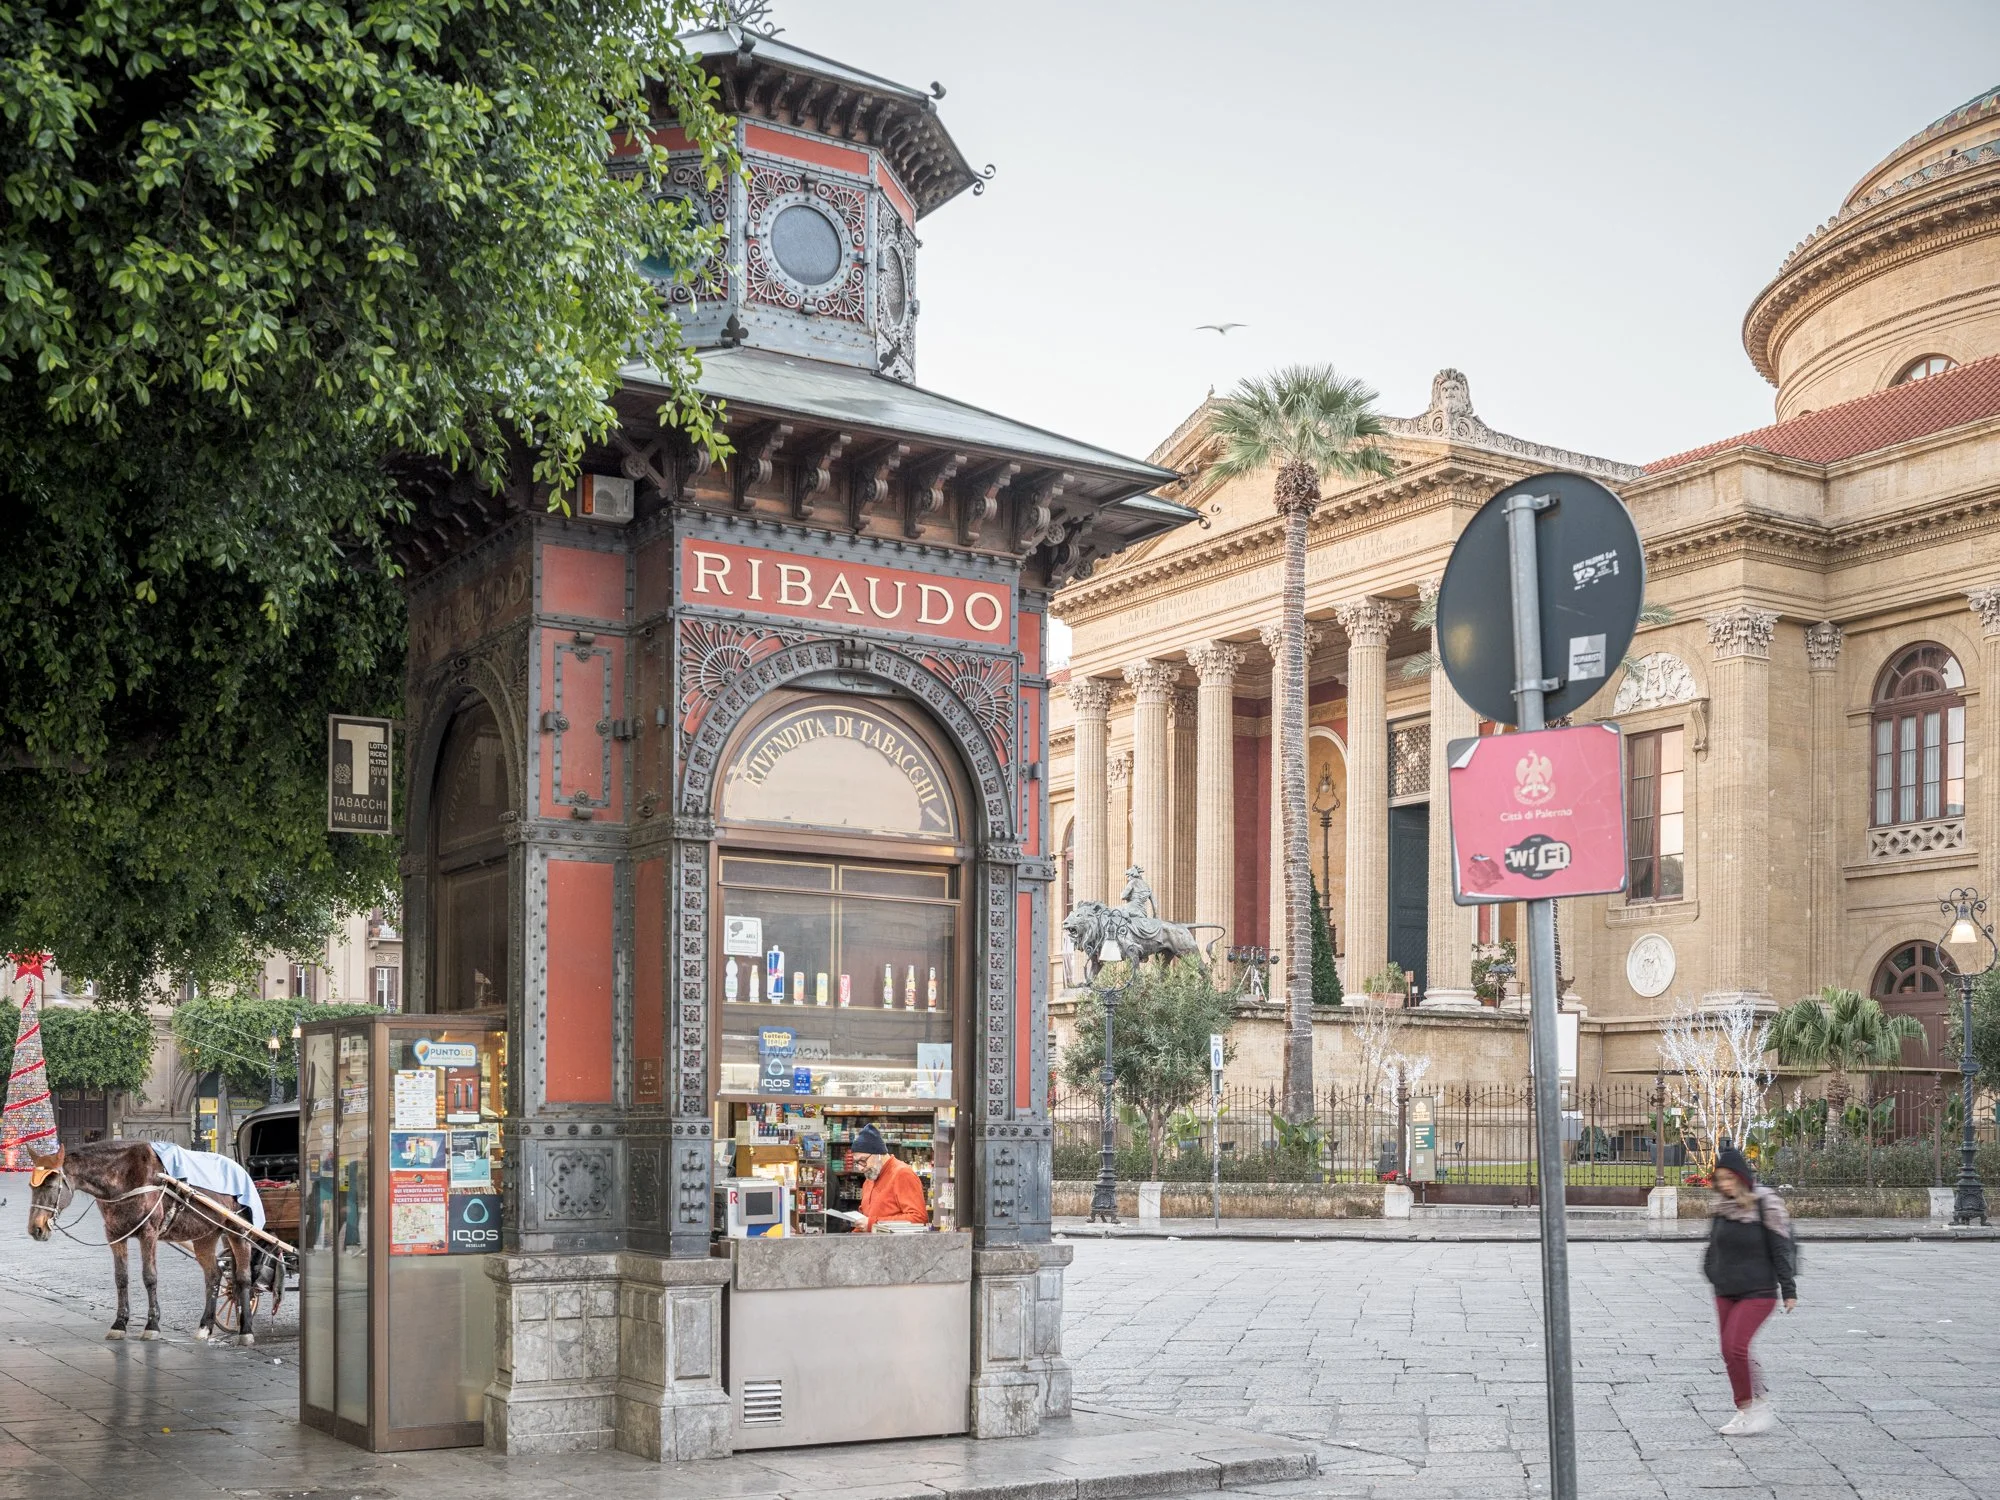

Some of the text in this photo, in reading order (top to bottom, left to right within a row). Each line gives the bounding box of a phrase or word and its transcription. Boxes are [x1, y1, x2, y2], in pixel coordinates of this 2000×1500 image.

[692, 550, 1003, 632] RIBAUDO
[338, 724, 384, 795] T
[743, 715, 938, 805] RIVENDITA DI TABACCHI
[333, 796, 387, 810] TABACCHI
[351, 813, 387, 825] BOLLATI
[1499, 808, 1573, 822] Città di Palermo
[761, 1079, 791, 1088] IQOS
[452, 1229, 499, 1243] IQOS
